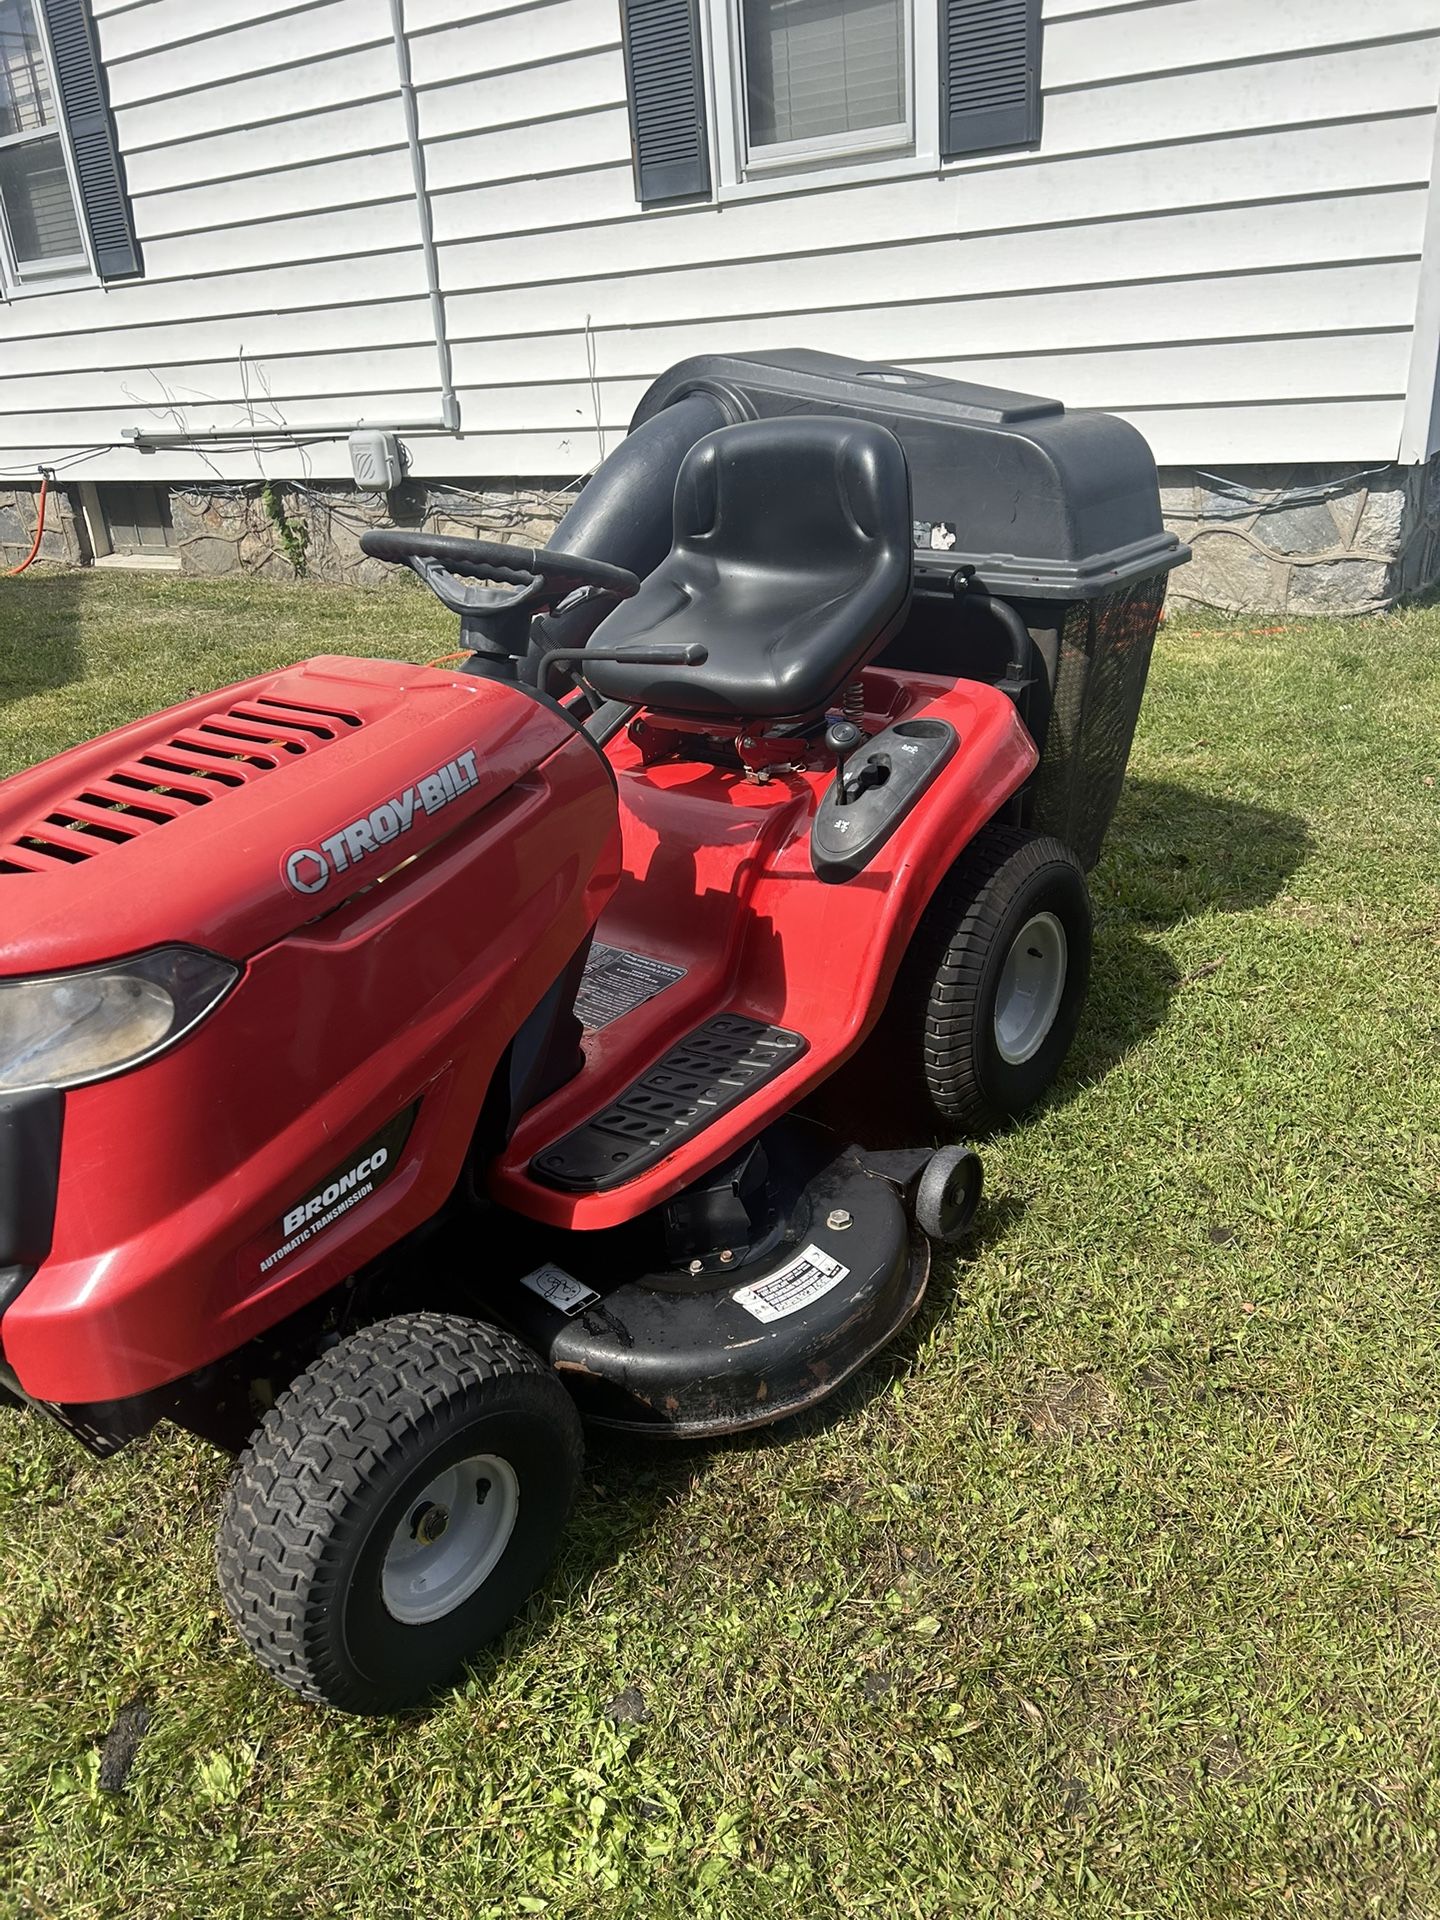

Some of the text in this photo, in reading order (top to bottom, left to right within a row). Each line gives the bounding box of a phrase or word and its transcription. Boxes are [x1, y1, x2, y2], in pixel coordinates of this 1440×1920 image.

[320, 748, 480, 873] TROY-BILT
[259, 1181, 374, 1272] AUTOMATIC TRANSMISSION
[283, 1147, 388, 1237] BRONCO
